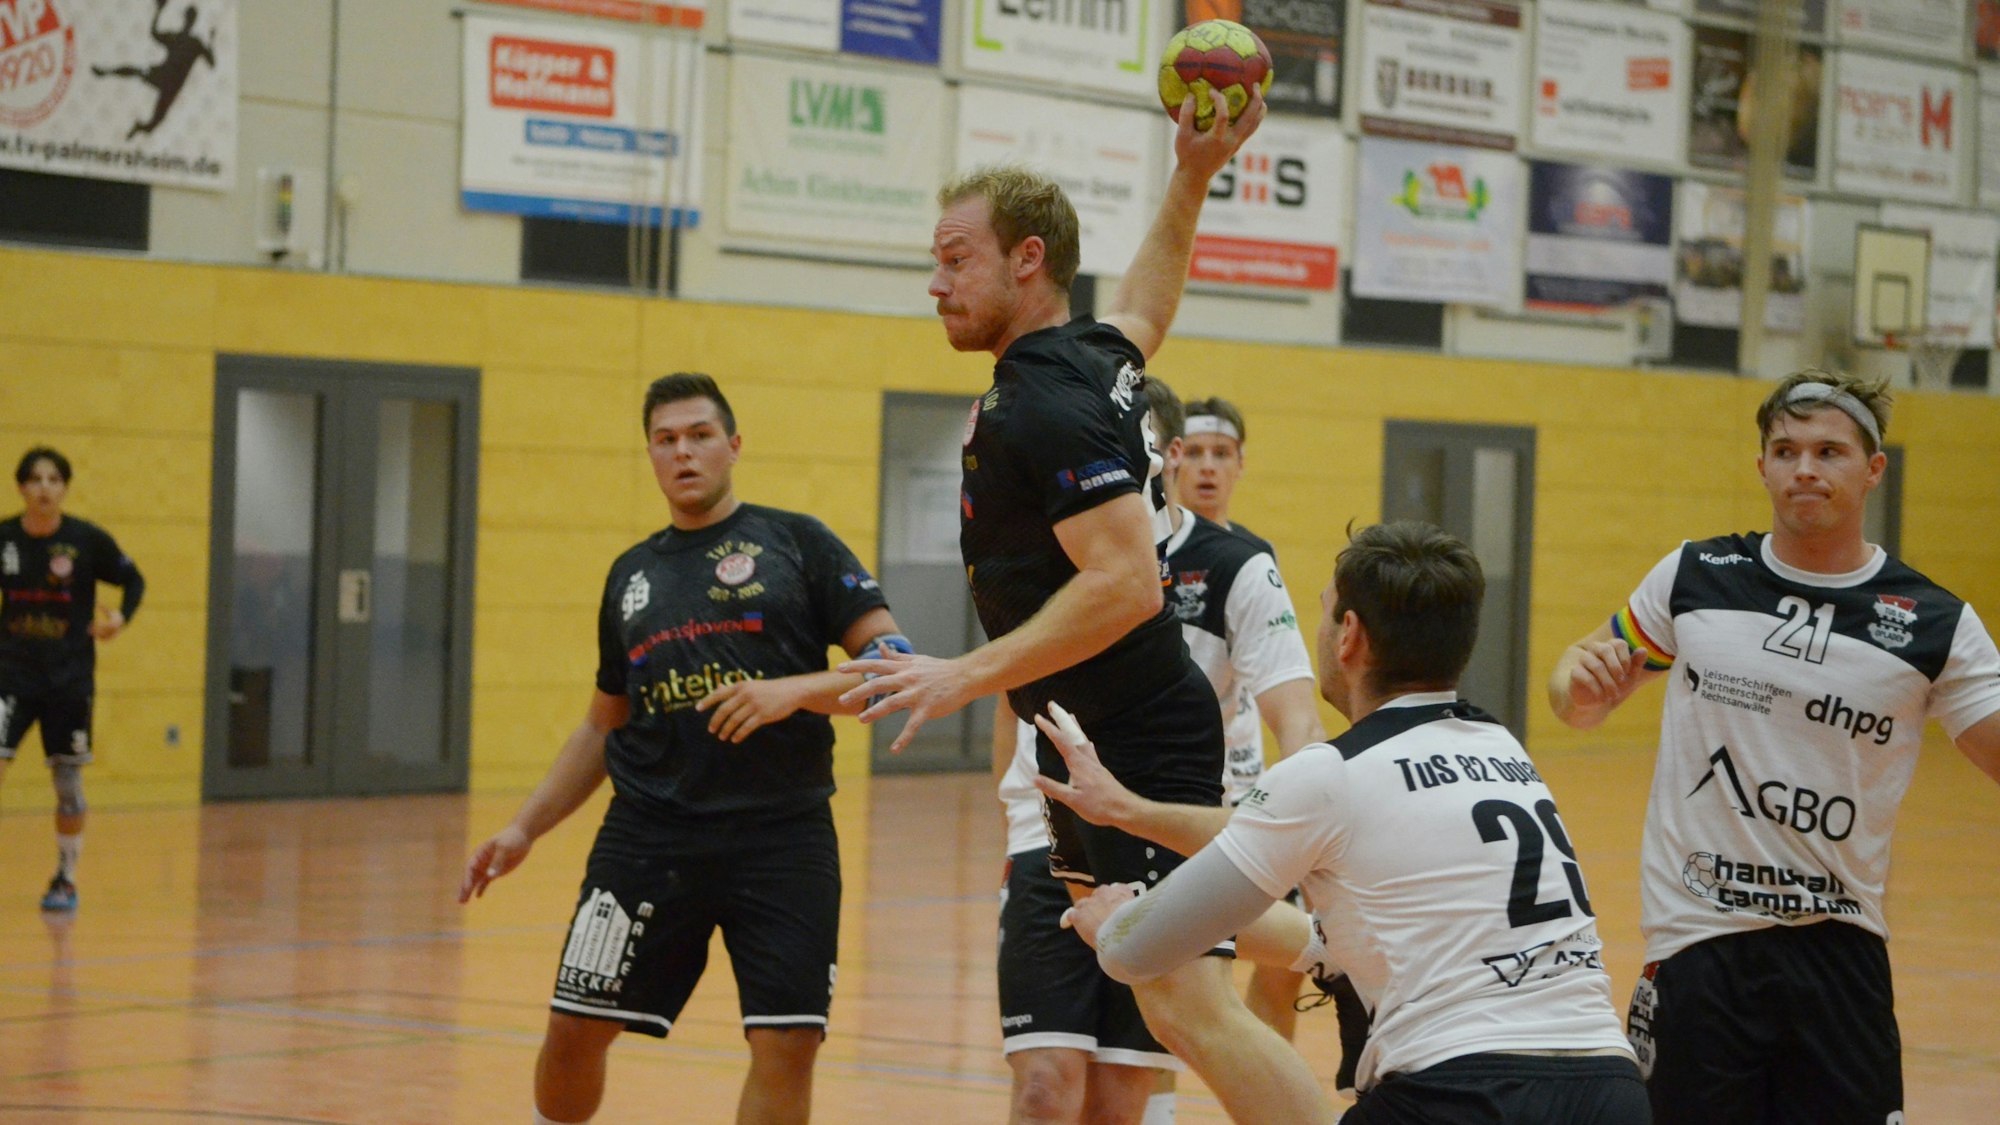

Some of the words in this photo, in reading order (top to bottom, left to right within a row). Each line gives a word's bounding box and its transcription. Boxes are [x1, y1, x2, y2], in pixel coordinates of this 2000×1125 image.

[1763, 595, 1836, 665] 21
[1702, 679, 1773, 705] Partnerschaft
[1703, 667, 1792, 699] LeisnerSchiffgen
[1701, 690, 1771, 715] Rechtsanwälte
[1805, 694, 1894, 745] dhpg
[1393, 754, 1459, 792] TuS
[1455, 754, 1498, 783] 82
[559, 966, 624, 993] BECKER
